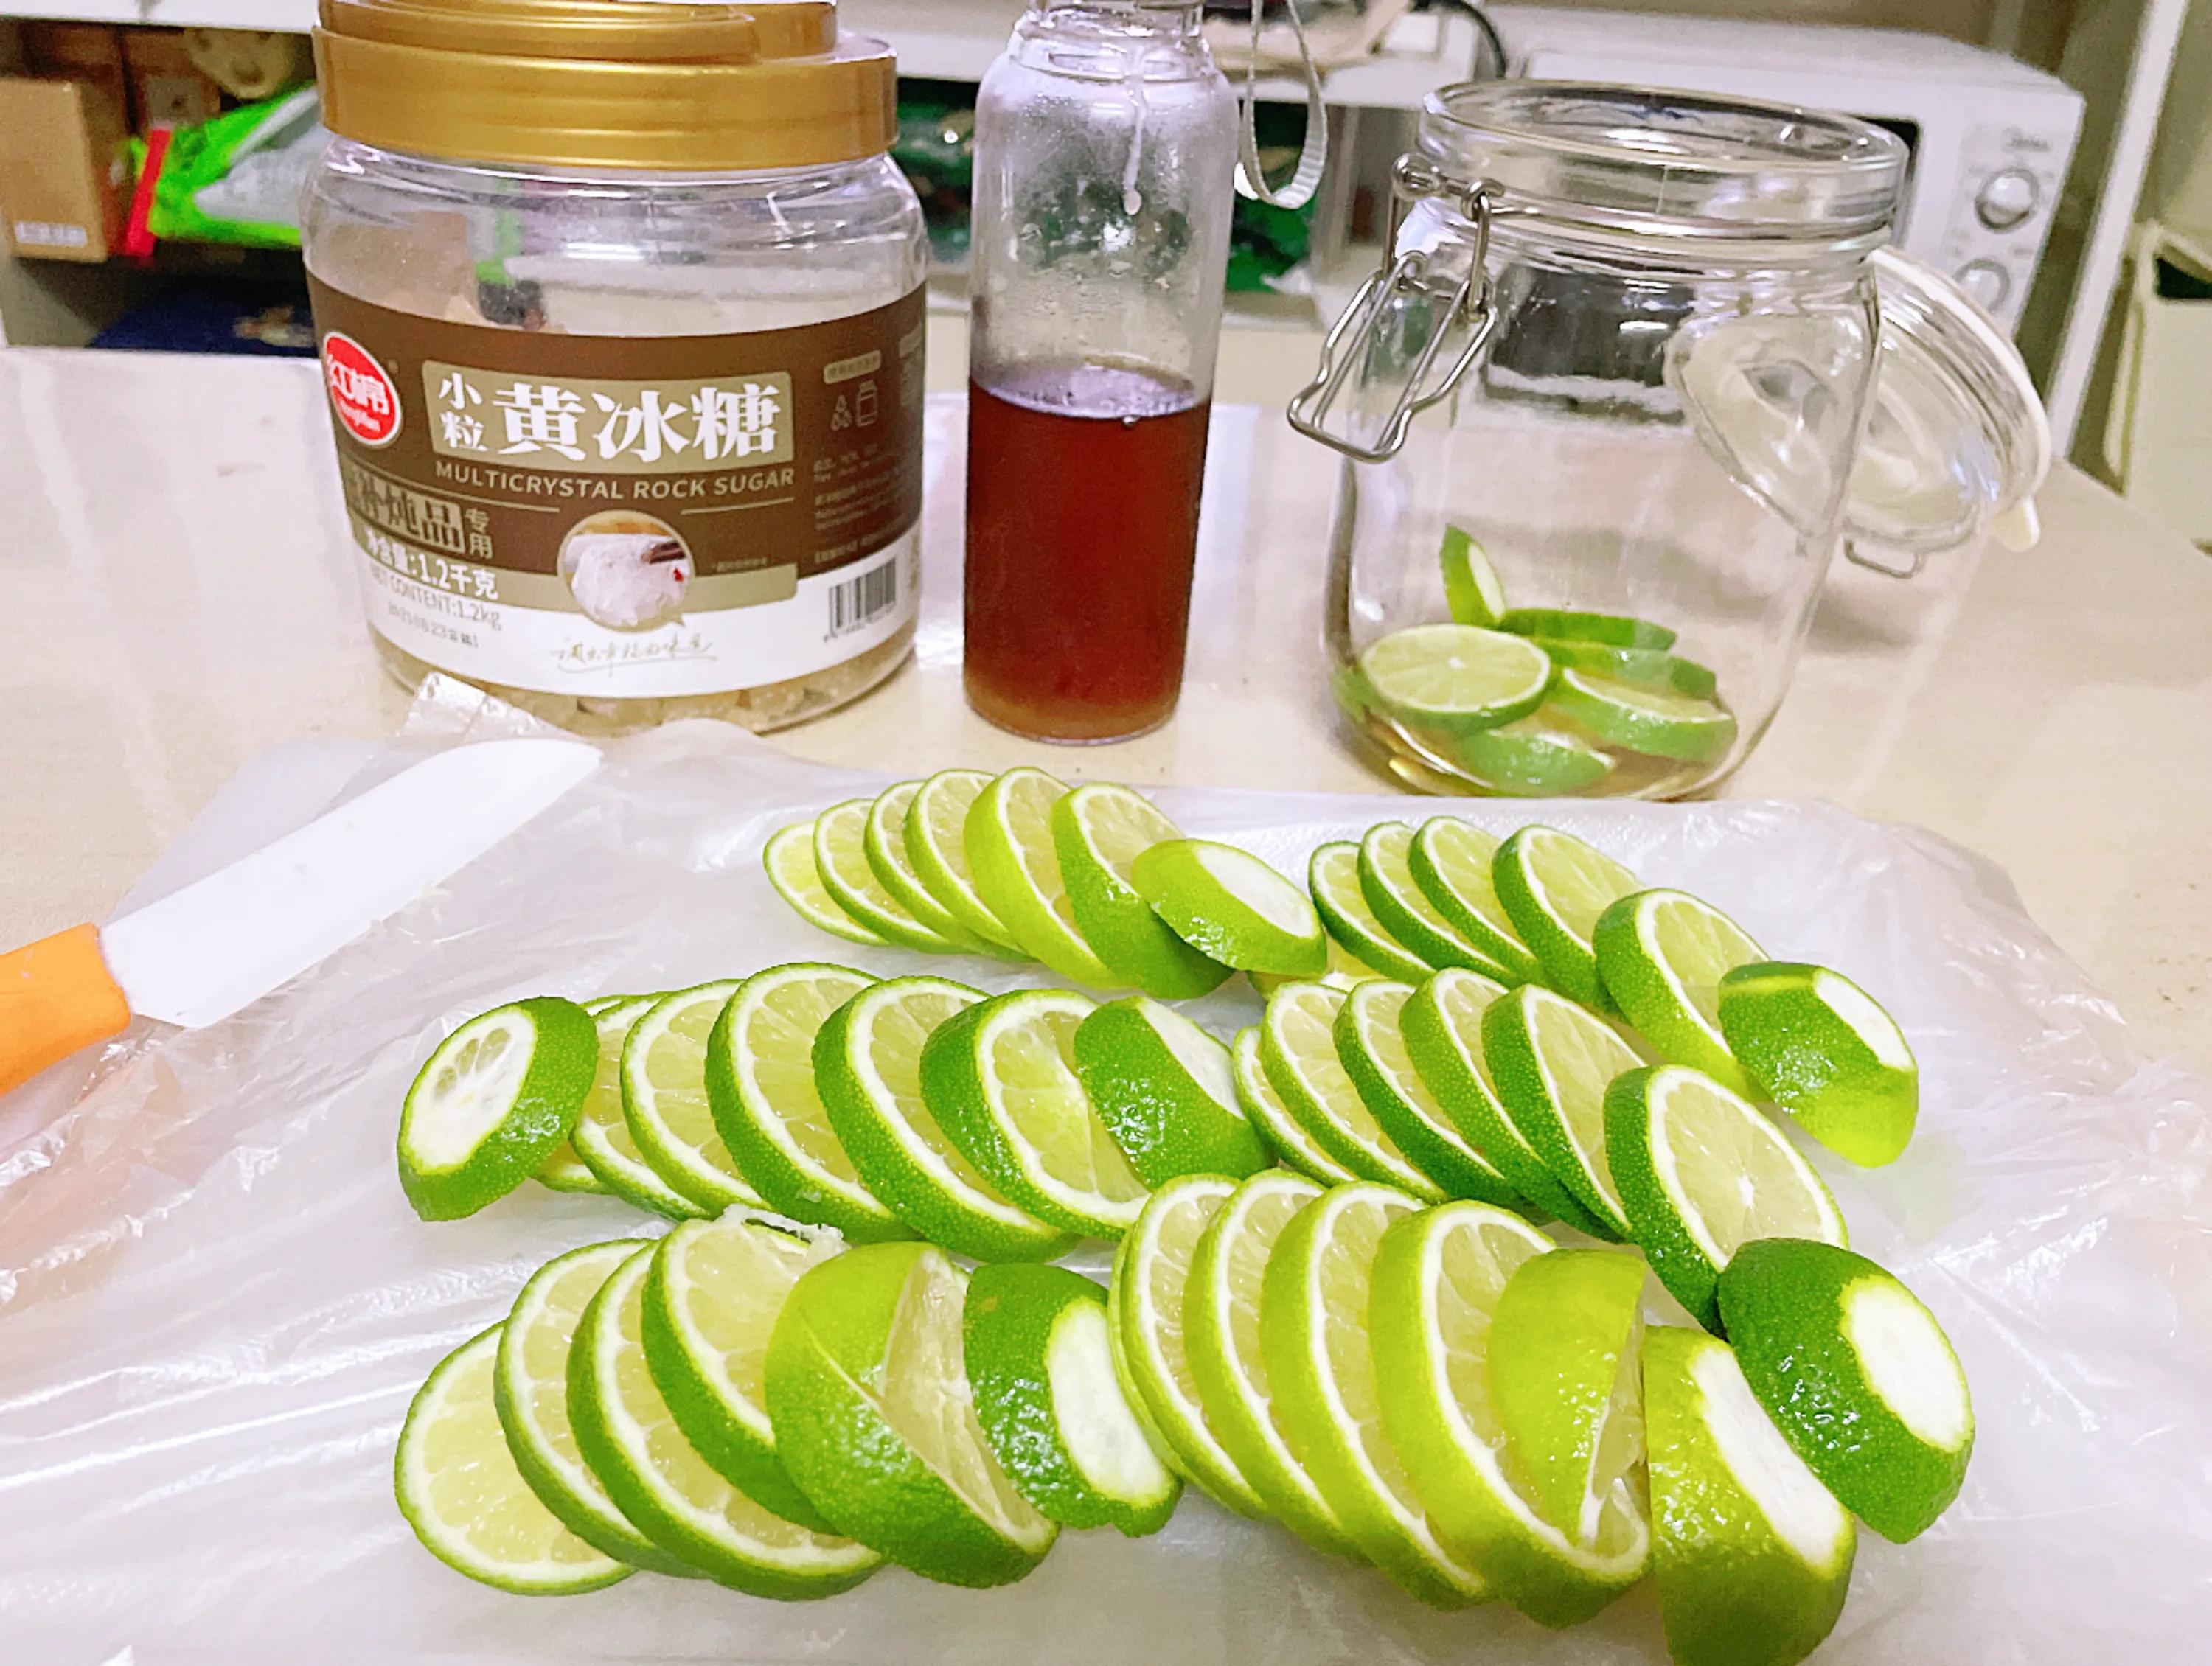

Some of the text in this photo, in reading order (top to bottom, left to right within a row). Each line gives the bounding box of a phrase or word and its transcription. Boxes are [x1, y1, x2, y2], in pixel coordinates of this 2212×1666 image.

[439, 372, 488, 452] 小粒
[492, 383, 781, 463] 黄冰糖
[435, 460, 795, 500] MULTICRYSTAL ROCK SUGAR
[466, 507, 493, 560] 专用
